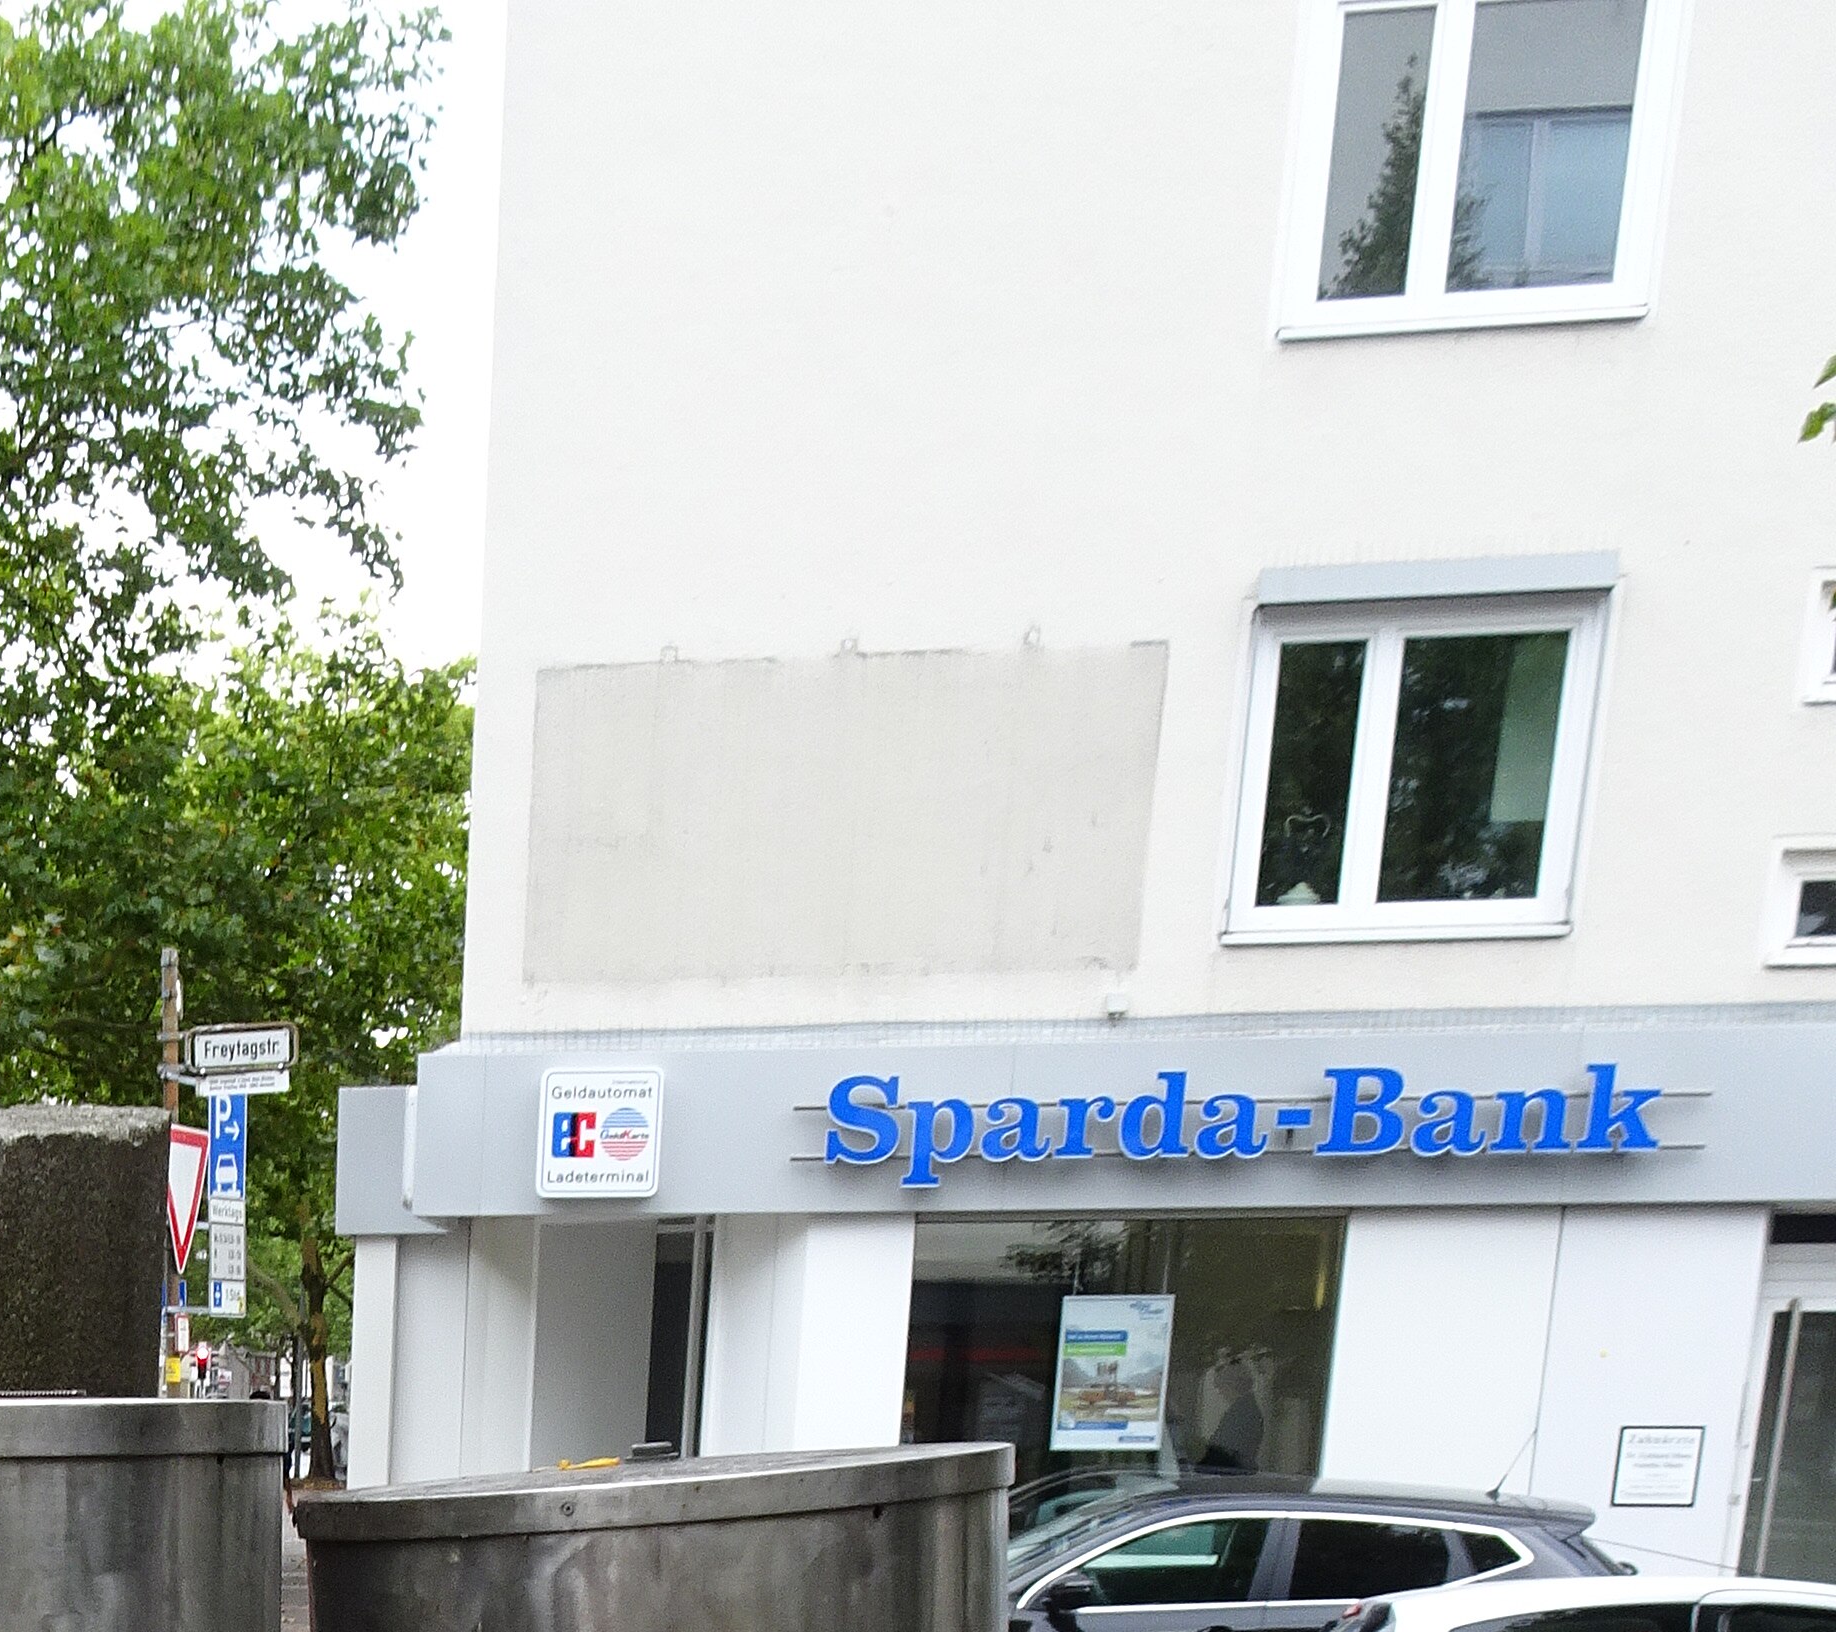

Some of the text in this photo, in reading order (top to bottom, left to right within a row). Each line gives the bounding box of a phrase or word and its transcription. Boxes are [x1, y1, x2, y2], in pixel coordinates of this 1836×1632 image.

[204, 1038, 280, 1061] Freytagstr.
[551, 1085, 653, 1100] Geldautomat
[824, 1063, 1661, 1188] Sparda-Bank
[547, 1170, 650, 1183] Ladeterminal
